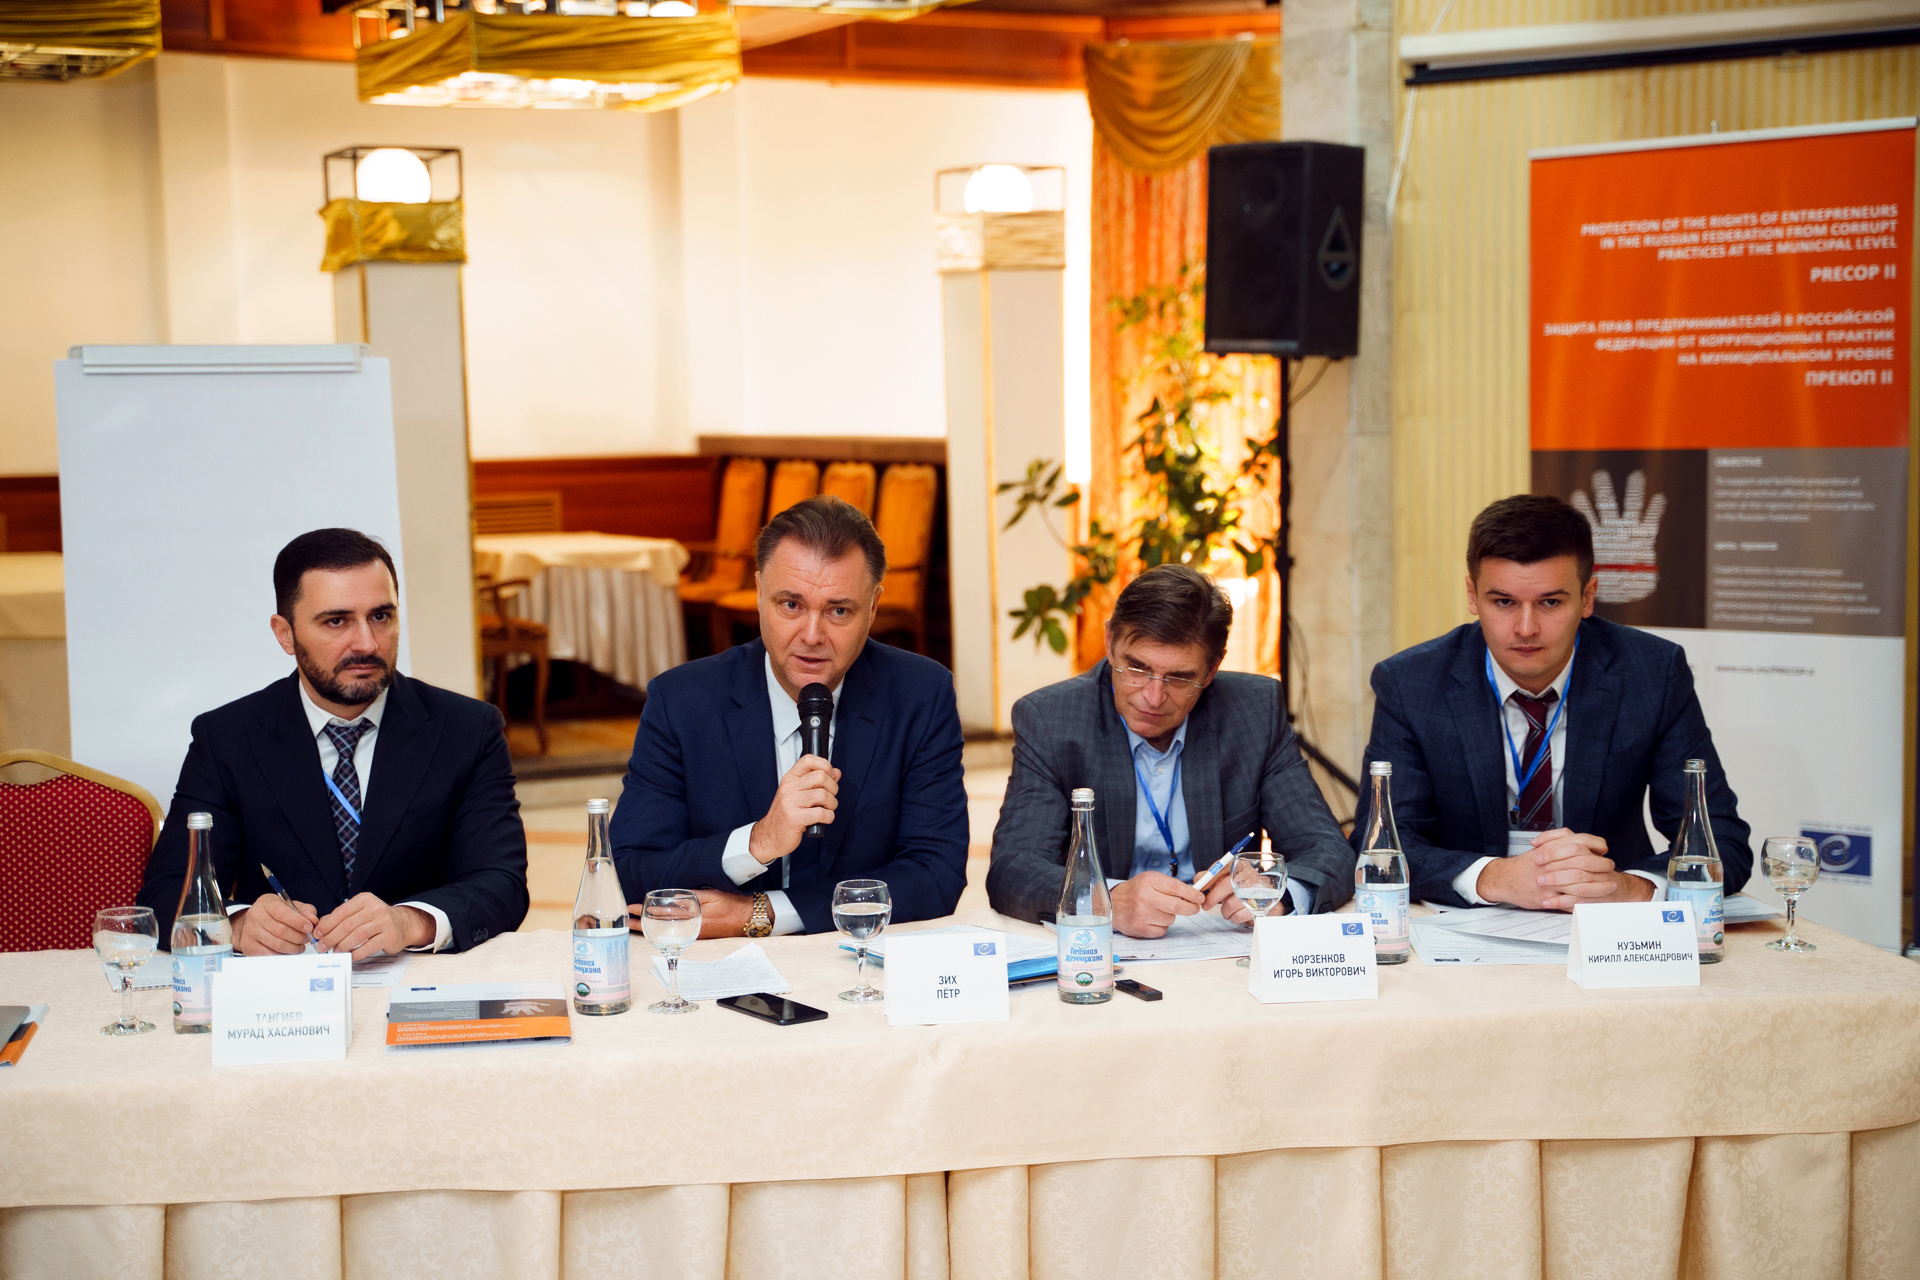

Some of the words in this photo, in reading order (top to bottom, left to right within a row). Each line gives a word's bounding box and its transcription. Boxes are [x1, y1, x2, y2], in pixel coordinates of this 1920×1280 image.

[1581, 220, 1659, 236] PROTECTION
[1662, 217, 1679, 230] OF
[1682, 216, 1707, 229] THE
[1709, 212, 1757, 228] RIGHTS
[1759, 211, 1779, 225] OF
[1781, 204, 1898, 224] ENTREPRENEURS
[1600, 237, 1615, 249] IN
[1617, 235, 1641, 248] THE
[1642, 232, 1700, 248] RUSSIAN
[1701, 226, 1784, 244] FEDERATION
[1786, 223, 1827, 238] FROM
[1830, 219, 1898, 236] CORRUPT
[1658, 246, 1726, 261] PRACTICES
[1728, 244, 1745, 257] AT
[1748, 243, 1773, 256] THE
[1775, 238, 1852, 254] MUNICIPAL
[1855, 235, 1897, 250] LEVEL
[1810, 264, 1880, 282] PRECOP
[1883, 264, 1896, 279] II
[1543, 321, 1596, 337] ЗАЩИТА
[1598, 319, 1633, 334] ПРАВ
[1635, 312, 1781, 333] ПРЕДПРИНИМАТЕЛЕЙ
[1784, 313, 1794, 327] В
[1796, 307, 1895, 326] РОССИЙСКОЙ
[1594, 337, 1676, 352] ФЕДЕРАЦИИ
[1678, 335, 1695, 348] ОТ
[1698, 331, 1823, 348] КОРРУПЦИОННЫХ
[1826, 328, 1895, 343] ПРАКТИК
[1678, 353, 1698, 365] НА
[1700, 349, 1832, 366] МУНИЦИПАЛЬНОМ
[1835, 347, 1894, 362] УРОВНЕ
[1805, 369, 1876, 386] ПРЕКОП
[1880, 369, 1893, 385] II
[1070, 947, 1097, 955] Ледяная
[1618, 941, 1661, 950] КУЗЬМИН
[1292, 954, 1345, 964] КОРЗЕНКОВ
[1589, 954, 1621, 963] КИРИЛЛ
[1624, 953, 1693, 962] АЛЕКСАНДРОВИЧ
[1273, 969, 1303, 978] ИГОРЬ
[1306, 966, 1365, 977] ВИКТОРОВИЧ
[939, 975, 957, 985] ЗИХ
[937, 988, 960, 998] ПЁТР
[256, 1012, 302, 1023] ТАНГИЕВ
[228, 1028, 264, 1039] МУРАД
[268, 1025, 330, 1037] ХАСАНОВИЧ
